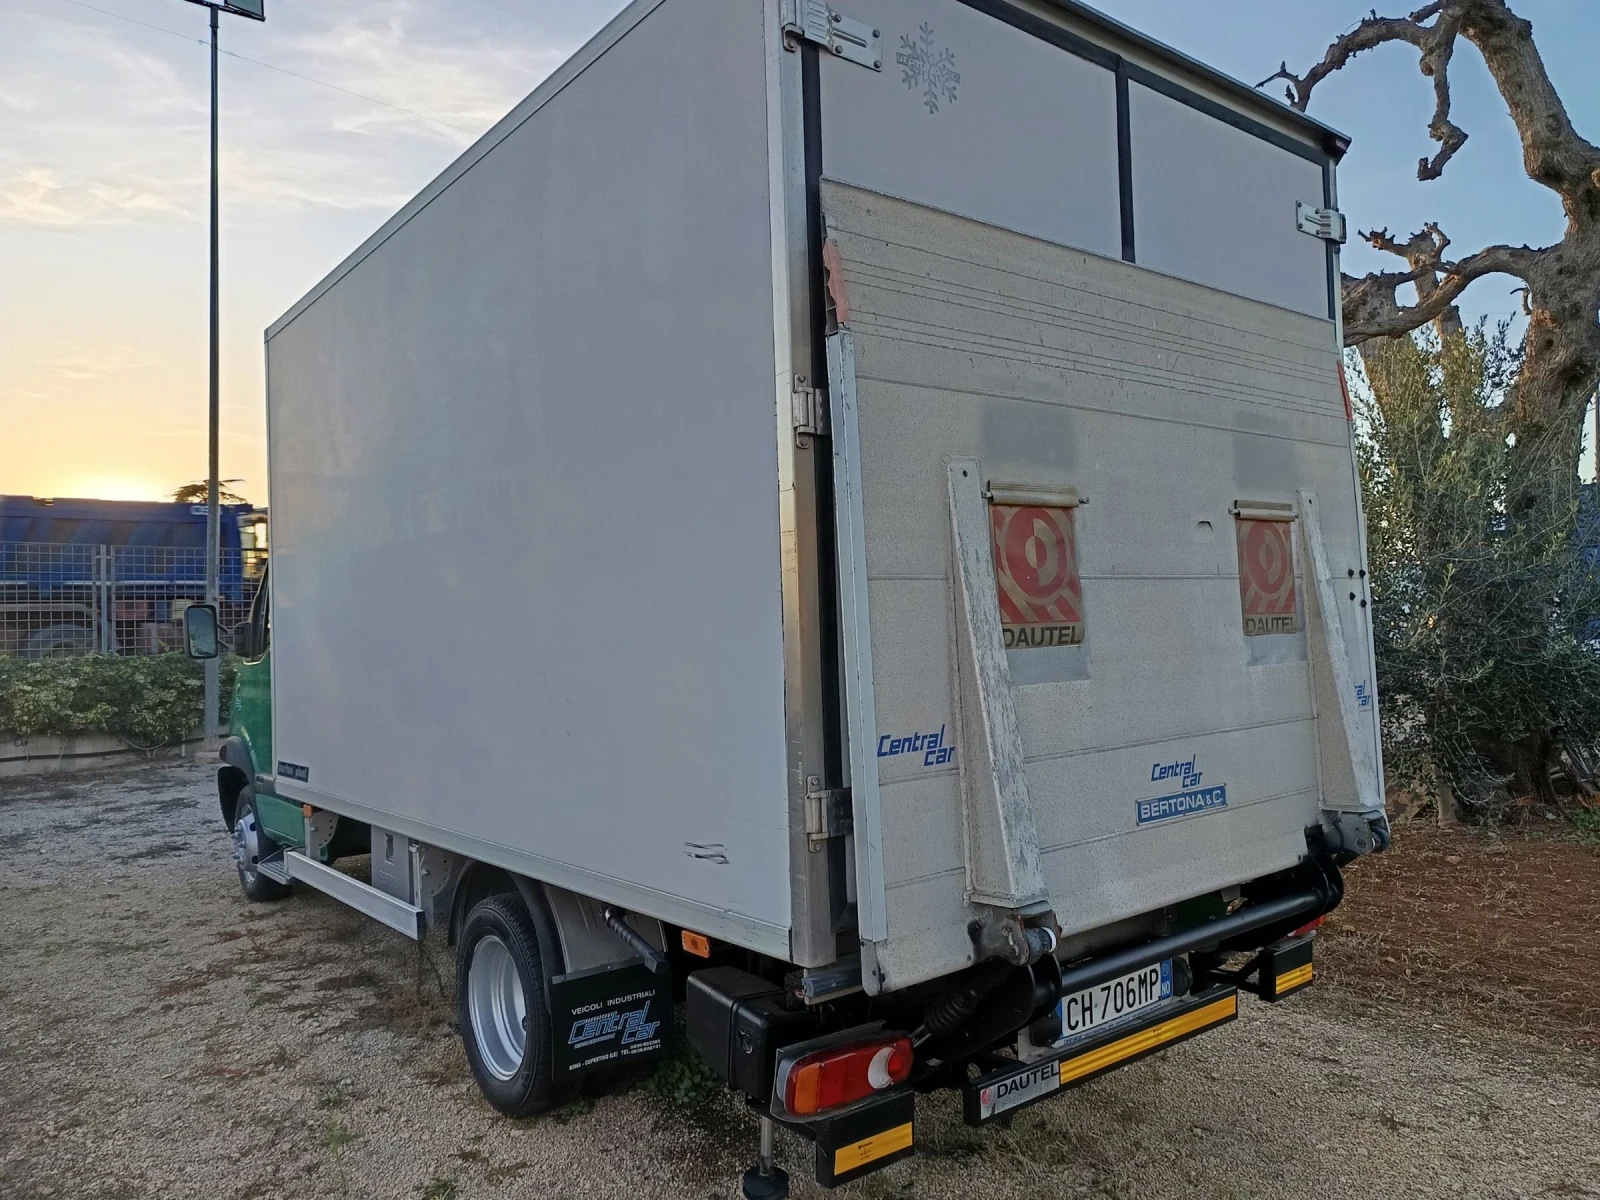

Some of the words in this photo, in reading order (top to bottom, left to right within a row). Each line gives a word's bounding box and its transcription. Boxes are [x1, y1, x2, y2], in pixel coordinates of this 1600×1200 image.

[1002, 625, 1081, 647] DAUTEL
[877, 724, 945, 757] Central
[1151, 754, 1196, 782] Central
[571, 1002, 603, 1015] VEICOLI
[607, 989, 655, 1006] INDUSTRIALI
[568, 1000, 650, 1044] Central
[997, 1064, 1059, 1098] DAUTEL
